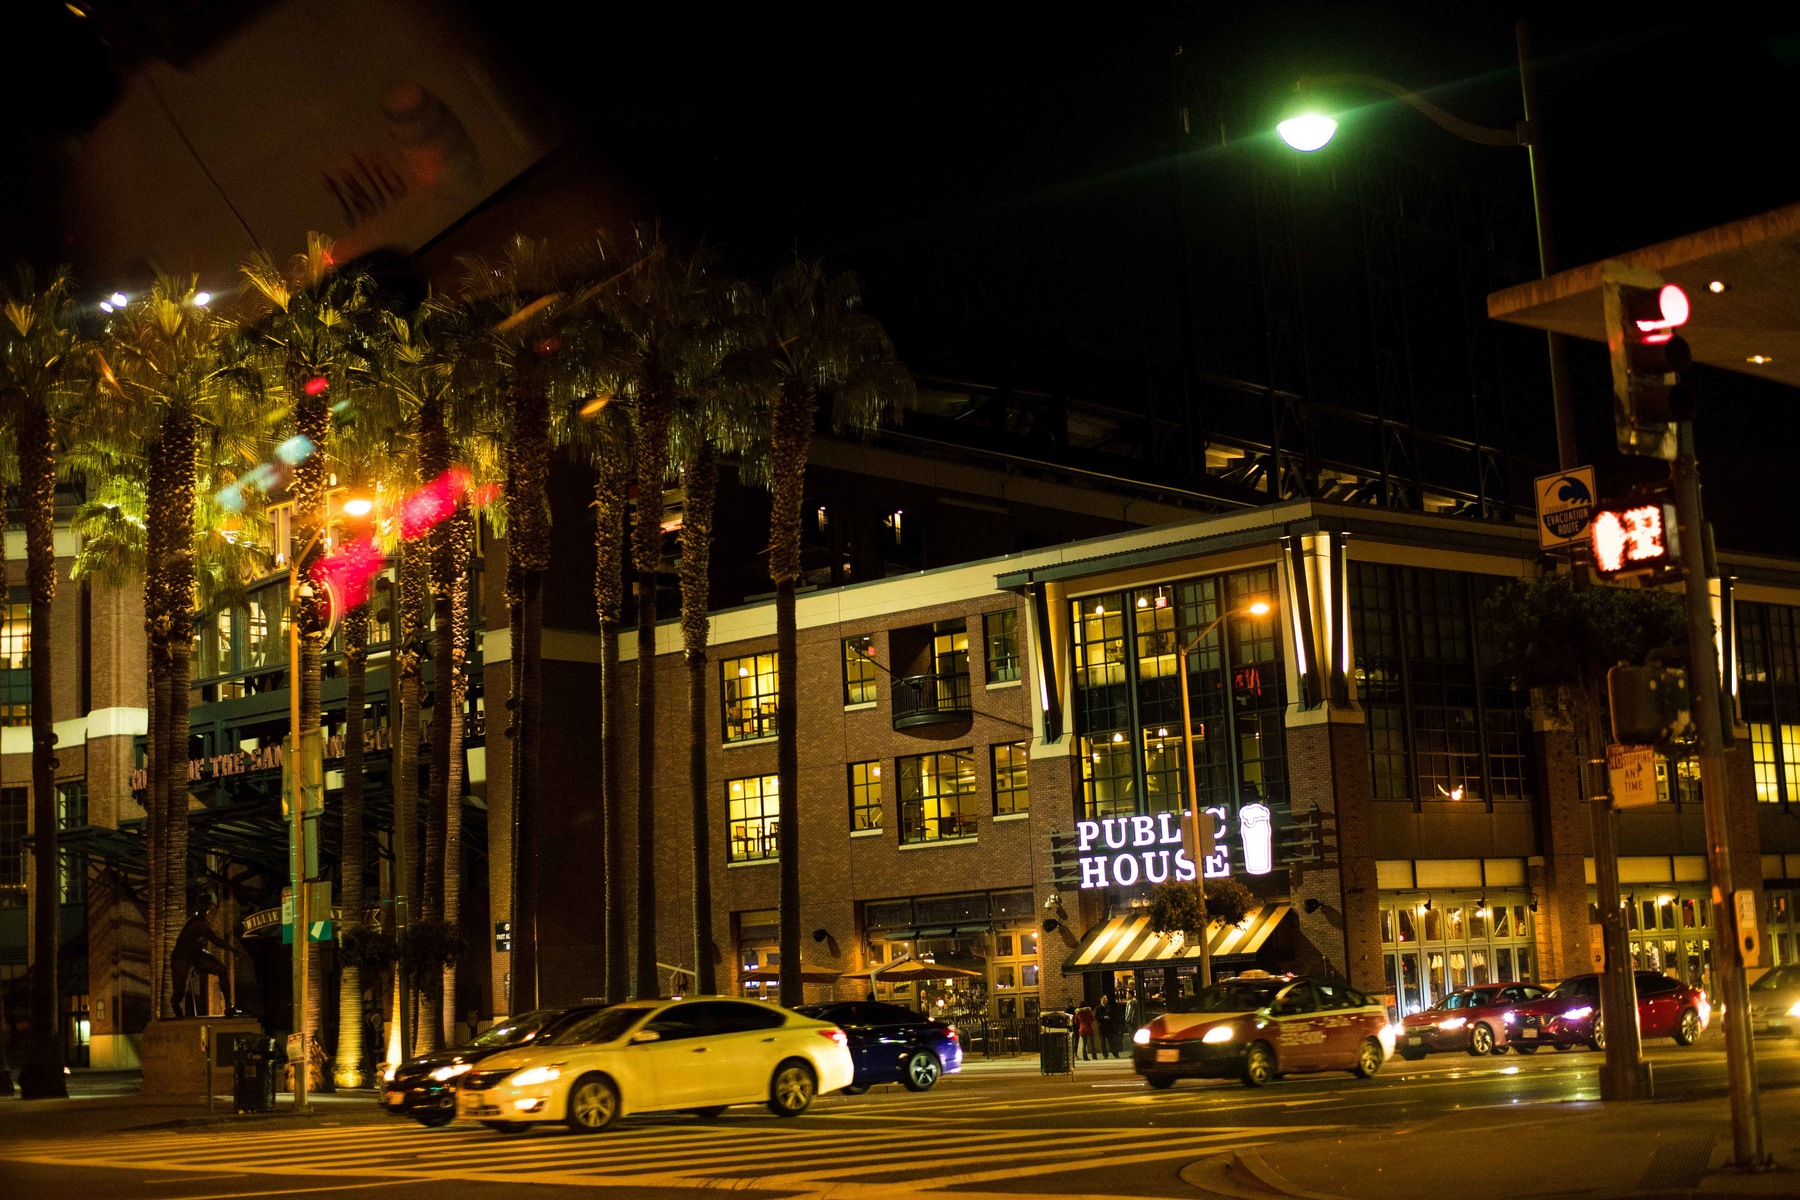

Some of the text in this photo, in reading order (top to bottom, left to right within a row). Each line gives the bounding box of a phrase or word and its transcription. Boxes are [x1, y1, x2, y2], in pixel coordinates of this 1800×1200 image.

[1546, 507, 1588, 527] EVACUATION
[1557, 520, 1579, 536] ROUTE
[210, 751, 246, 778] THE
[250, 744, 284, 771] SAN
[1609, 751, 1653, 769] NO STOPPING
[1624, 766, 1641, 780] ANY
[1624, 779, 1644, 793] TIME
[1076, 806, 1227, 852] PUBLC
[1079, 844, 1231, 889] HOUSE
[246, 911, 279, 929] WILLIE
